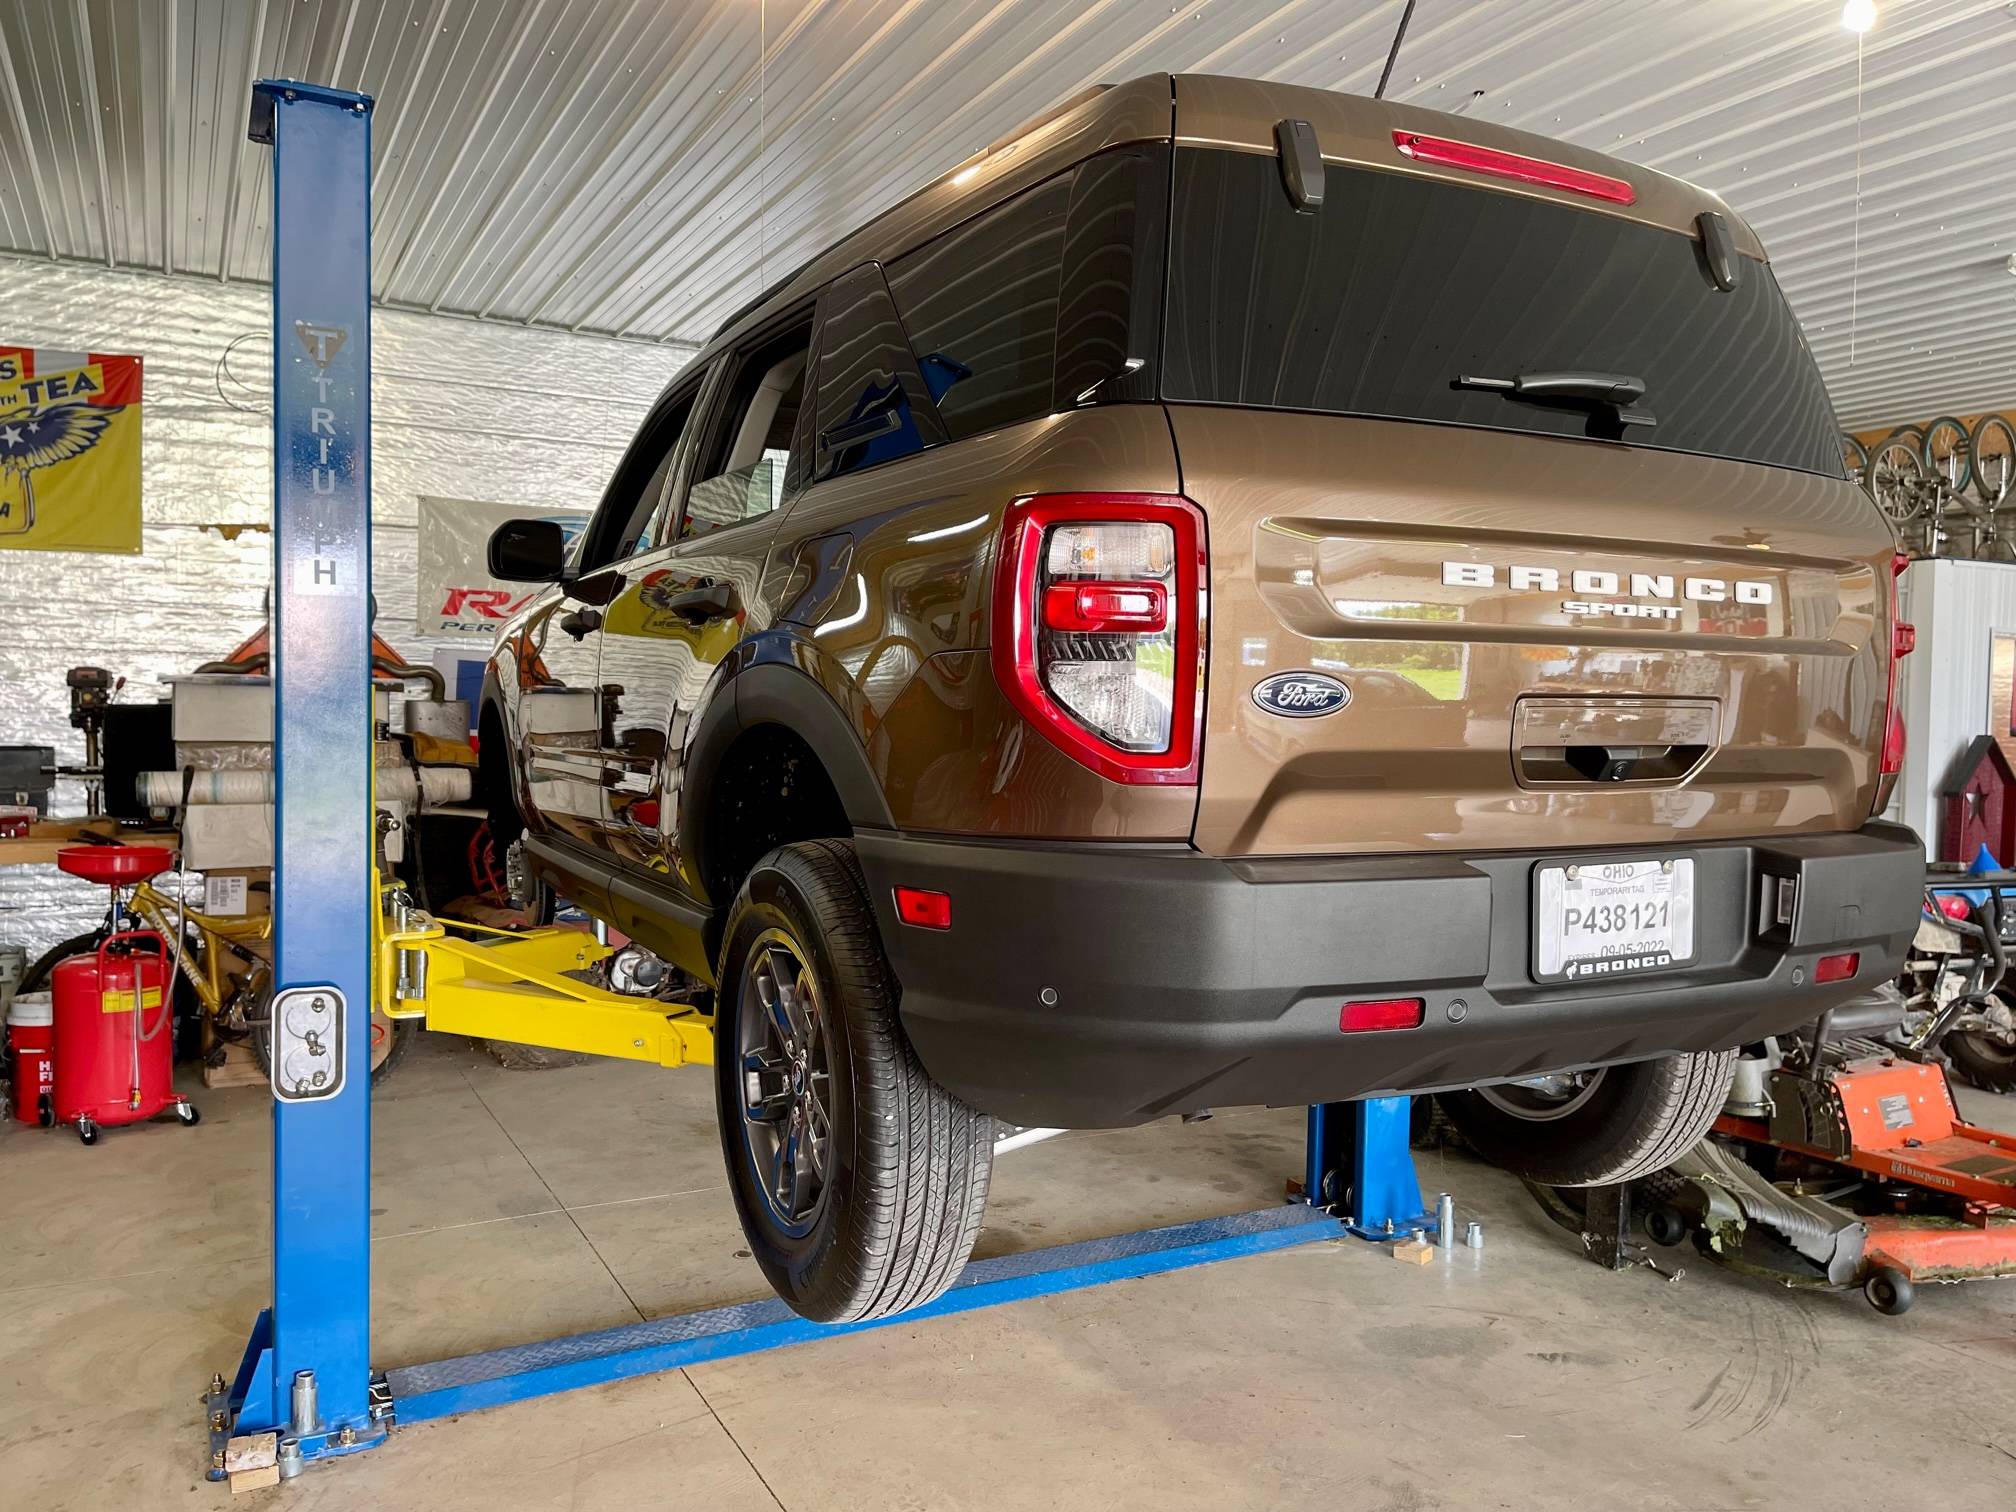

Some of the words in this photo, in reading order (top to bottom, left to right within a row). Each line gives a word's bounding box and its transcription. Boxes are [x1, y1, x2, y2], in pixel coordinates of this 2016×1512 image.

[20, 371, 99, 404] TEA
[1441, 560, 1772, 605] BRONCO
[1561, 600, 1683, 619] SPORT
[1277, 682, 1332, 706] Ford
[1602, 864, 1635, 879] OHIO
[1590, 886, 1632, 897] TEMPORARY
[1632, 885, 1645, 894] TAG
[1564, 900, 1669, 936] P438121
[1600, 939, 1664, 957] 09-05-2022
[1579, 954, 1670, 975] BRONCO
